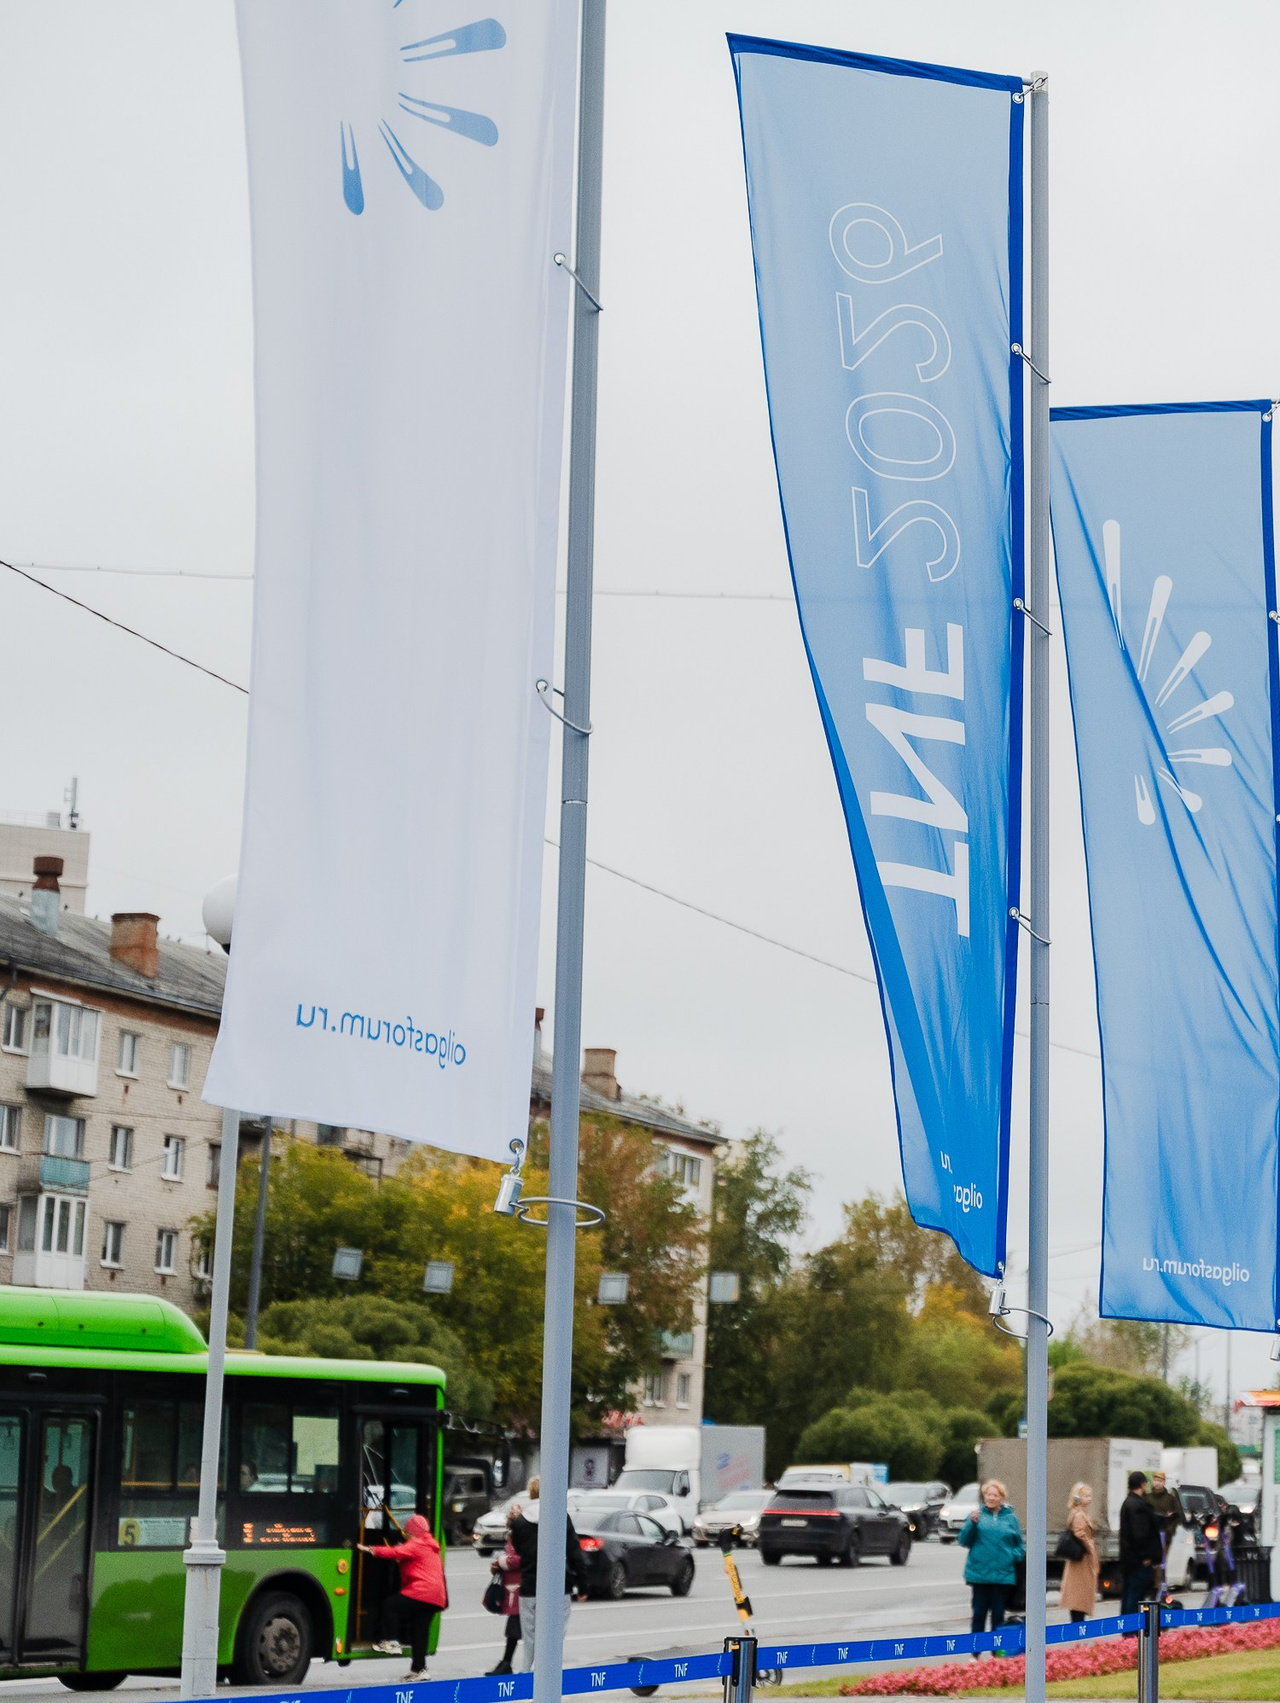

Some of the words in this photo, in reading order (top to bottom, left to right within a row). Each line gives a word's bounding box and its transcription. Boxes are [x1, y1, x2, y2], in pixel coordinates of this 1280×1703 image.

[946, 1639, 956, 1652] TNF
[993, 1635, 1002, 1647] TNF
[838, 1647, 849, 1660] TNF
[894, 1643, 904, 1656] TNF
[776, 1651, 788, 1665] TNF
[673, 1663, 688, 1678] TNF
[590, 1671, 606, 1687] TNF
[498, 1681, 515, 1698] TNF
